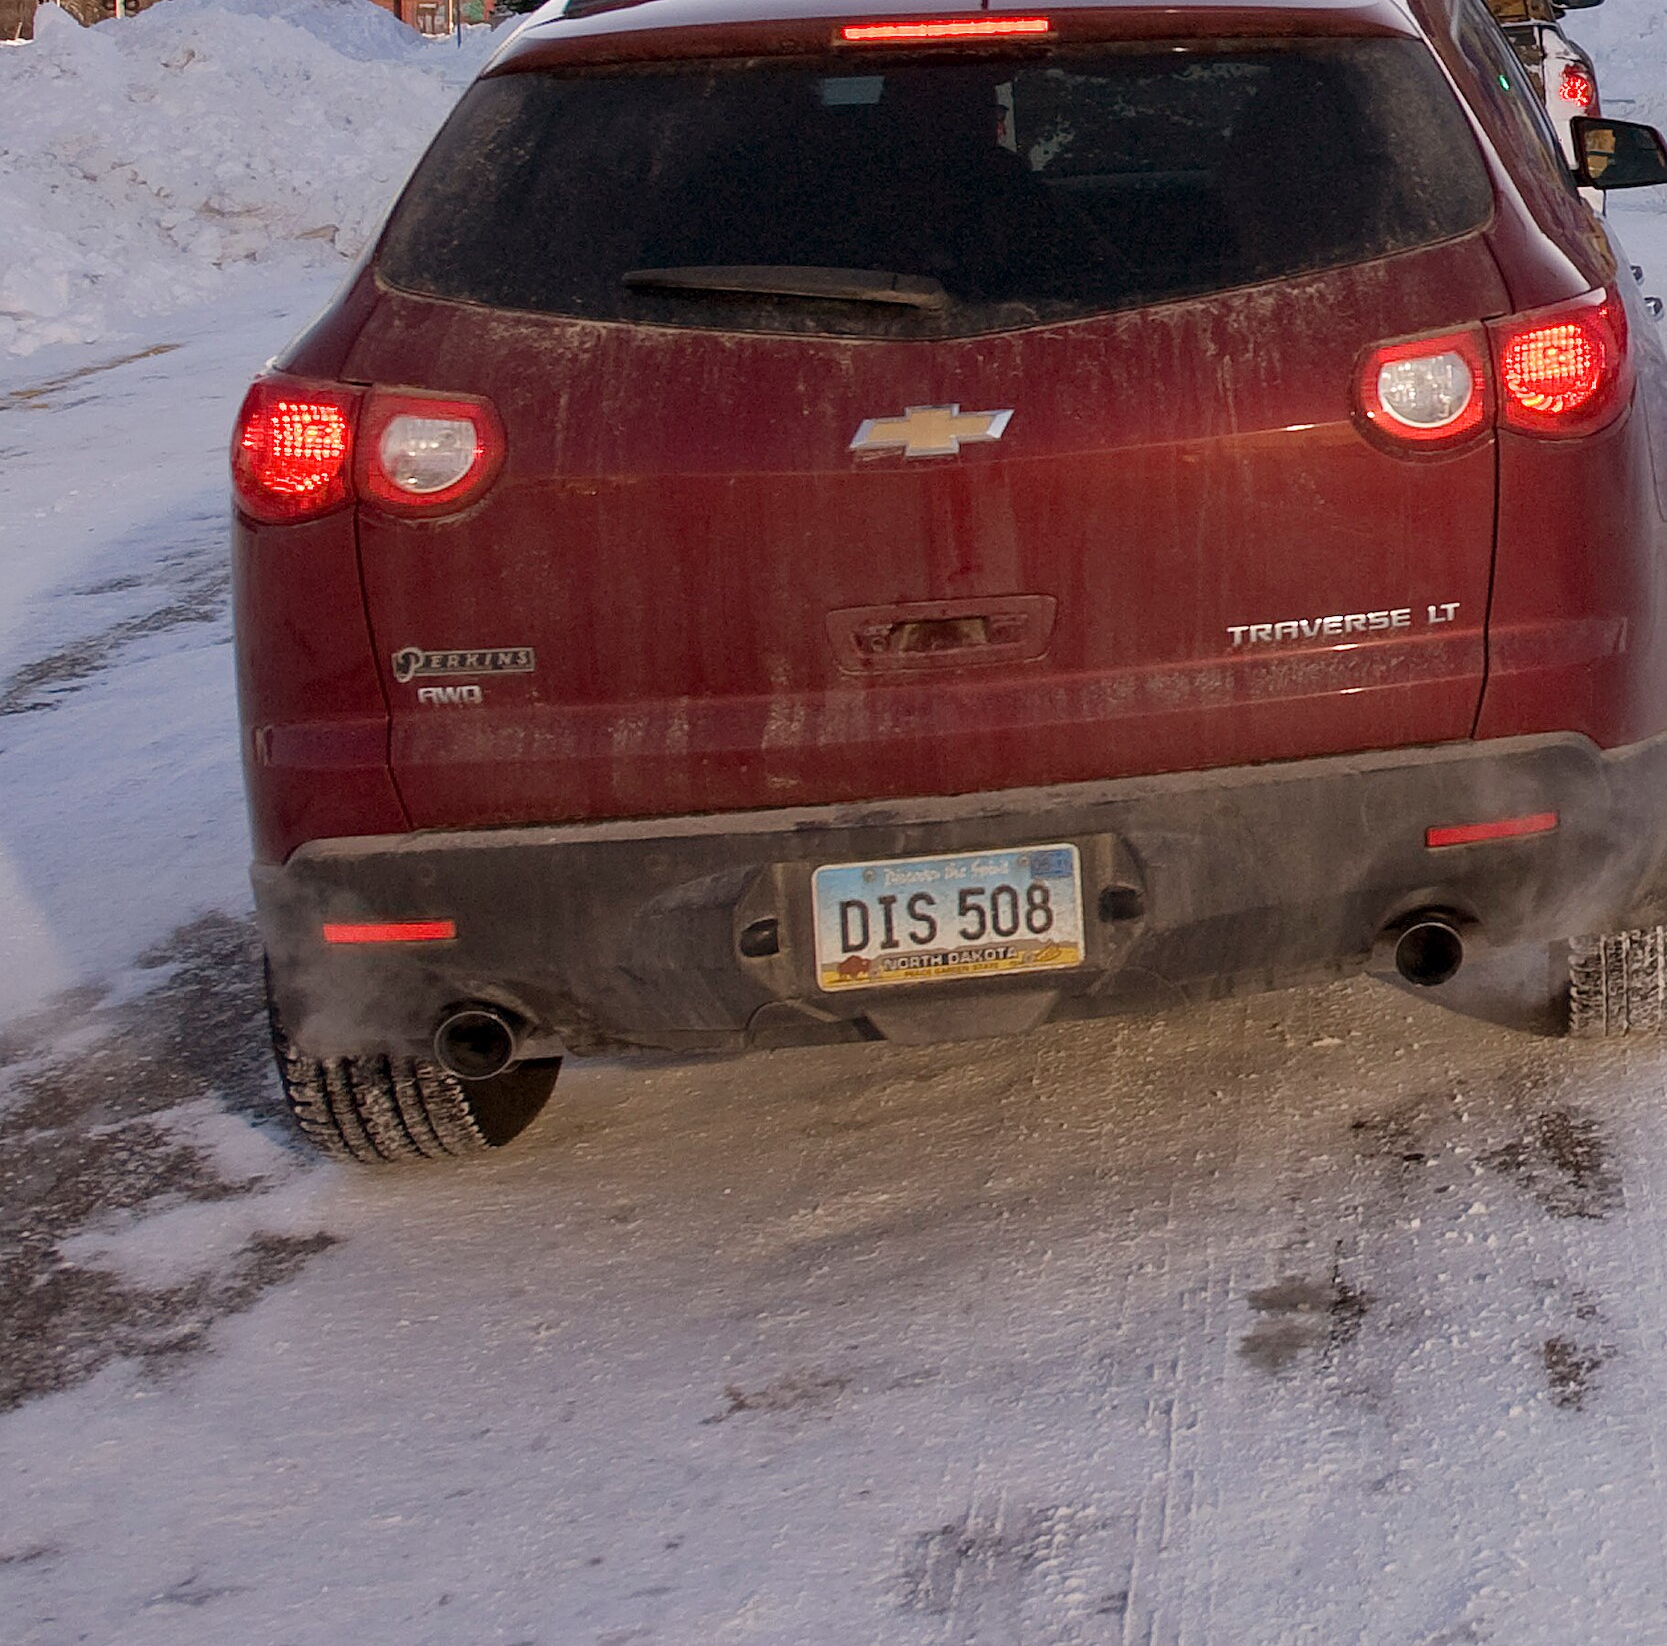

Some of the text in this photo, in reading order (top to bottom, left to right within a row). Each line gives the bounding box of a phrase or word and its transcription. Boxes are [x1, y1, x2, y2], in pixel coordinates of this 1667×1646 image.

[1226, 601, 1461, 647] TRAVERSE LT
[396, 646, 529, 683] PERKINS
[417, 685, 483, 704] AWD
[839, 883, 1054, 954] DIS 508
[883, 946, 1018, 971] NORTH DAKOTA
